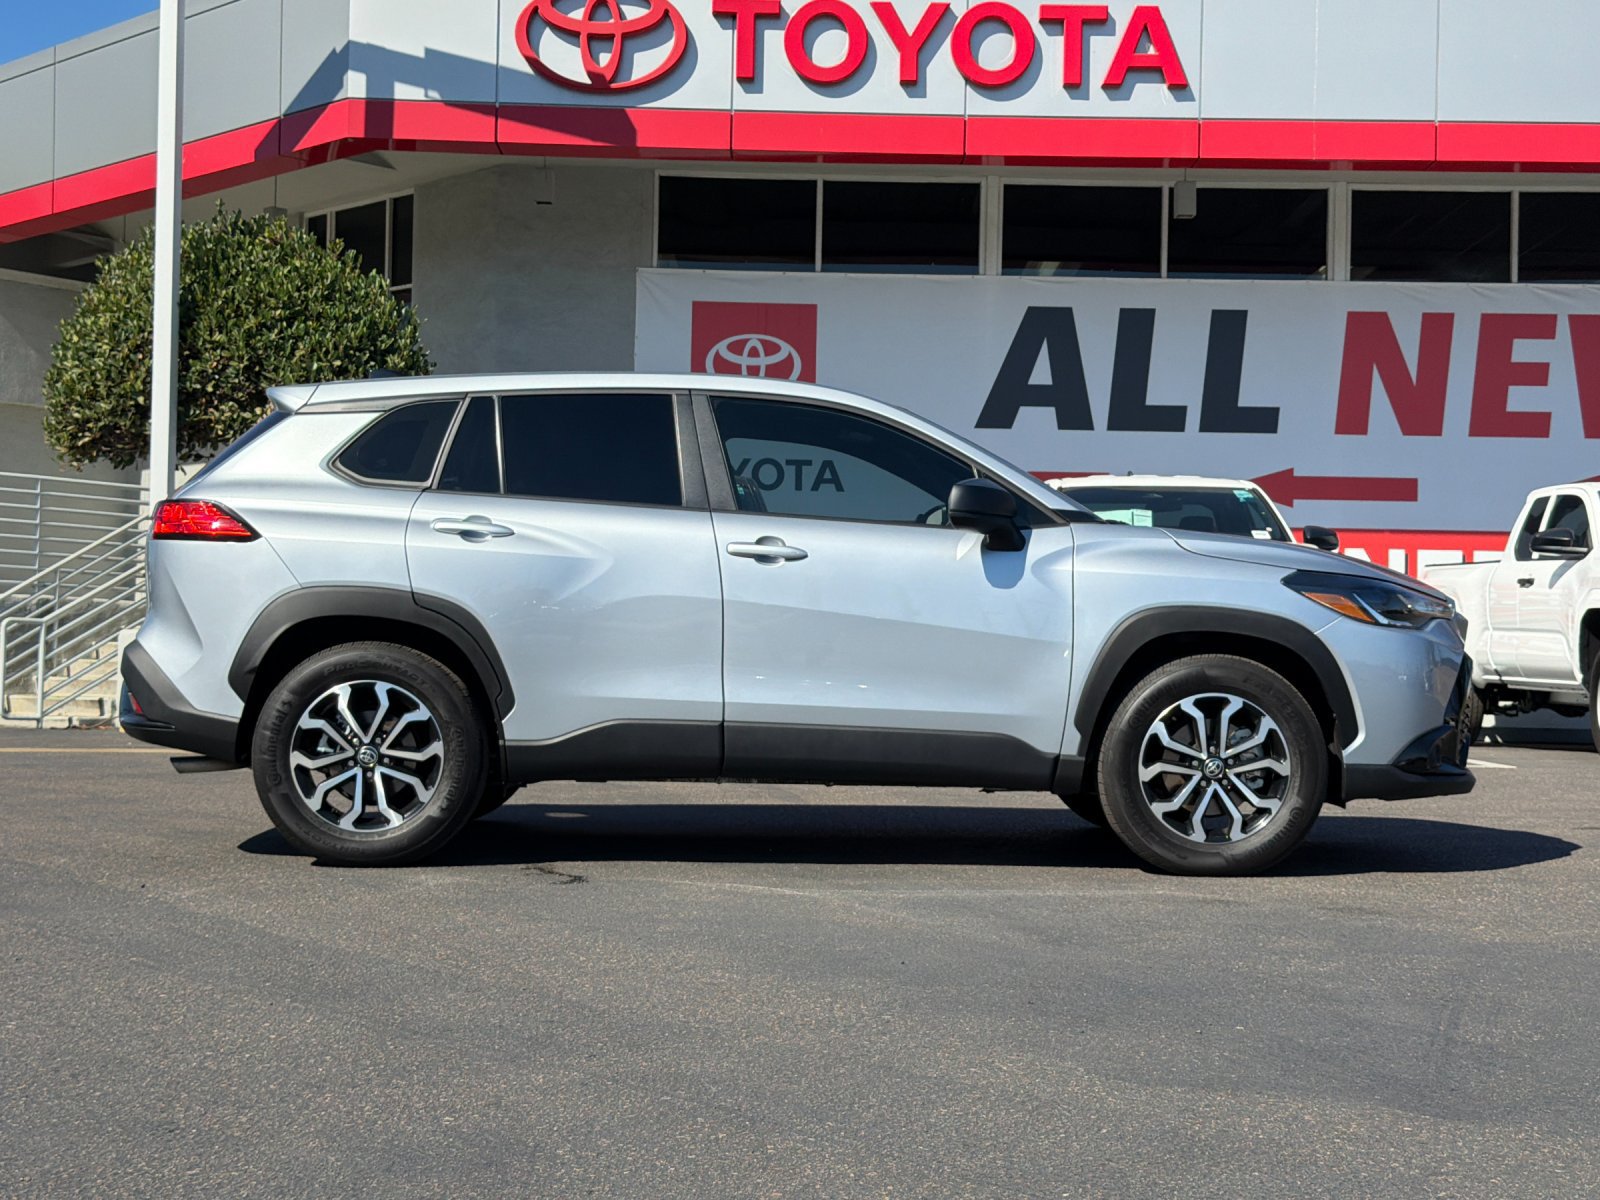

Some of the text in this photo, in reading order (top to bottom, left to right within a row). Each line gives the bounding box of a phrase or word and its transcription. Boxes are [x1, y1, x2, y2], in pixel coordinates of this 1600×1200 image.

[713, 0, 1188, 90] TOYOTA
[974, 306, 1600, 439] ALL NE
